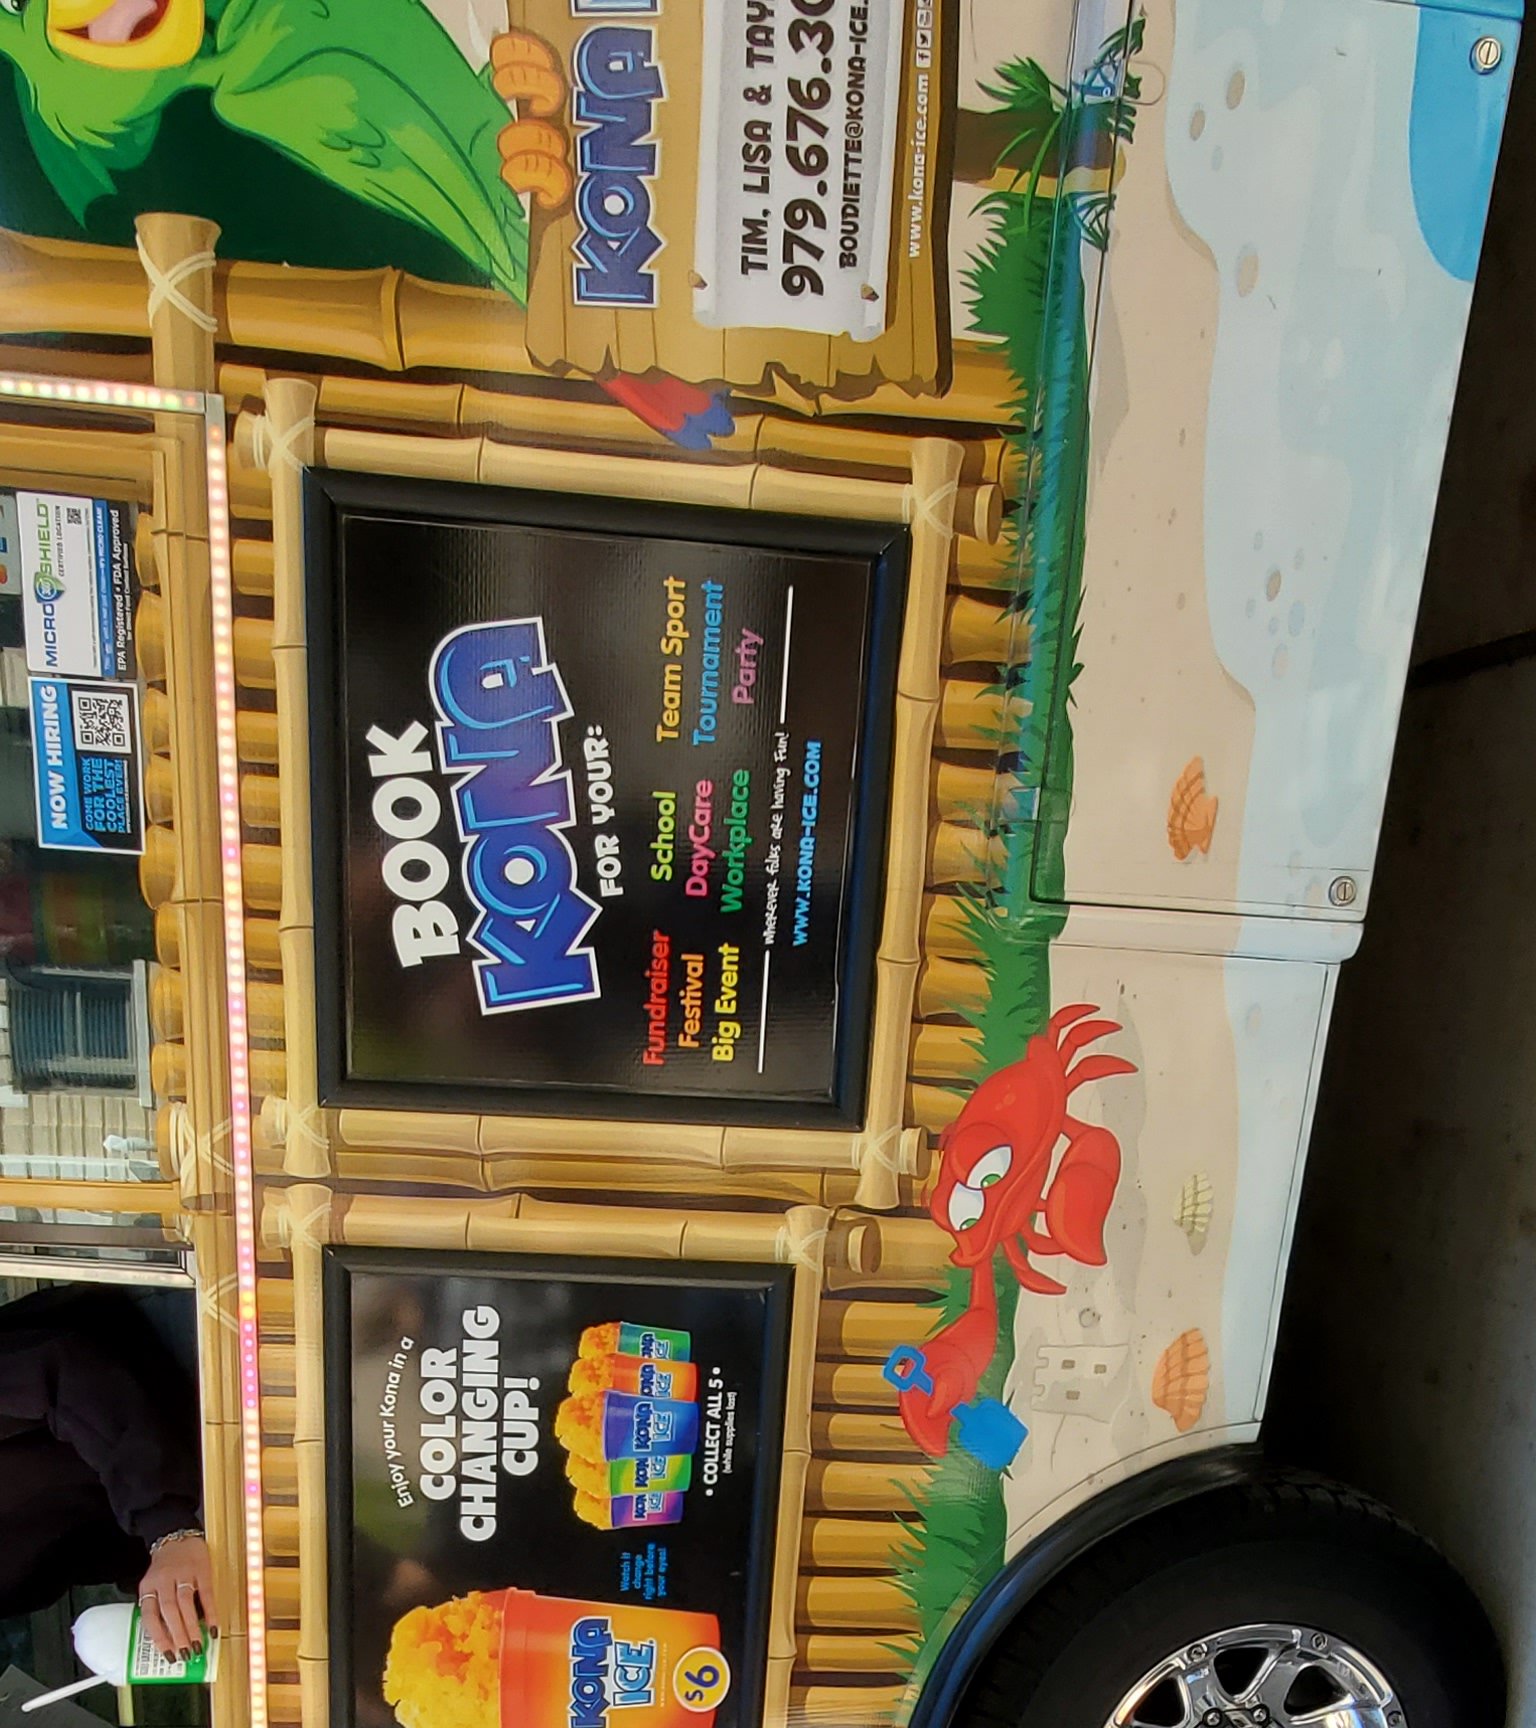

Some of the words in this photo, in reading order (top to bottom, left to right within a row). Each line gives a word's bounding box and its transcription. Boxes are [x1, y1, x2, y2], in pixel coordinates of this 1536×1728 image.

[746, 0, 774, 68] TAY
[743, 85, 772, 105] &
[570, 25, 667, 308] KONA
[742, 120, 772, 194] LISA
[907, 73, 930, 258] www.kona-ice.com
[741, 208, 772, 275] TIM,
[36, 503, 52, 575] SHIELD
[54, 505, 63, 541] LOCATION
[110, 509, 124, 561] Approved
[56, 542, 65, 577] CERTIFIED
[112, 564, 122, 585] FDA
[42, 603, 58, 667] MICRO
[114, 594, 128, 649] Registered
[660, 575, 690, 656] Sport
[117, 650, 127, 671] EPA
[691, 580, 724, 746] Tournament
[731, 627, 764, 704] Party
[655, 663, 683, 743] Team
[39, 685, 64, 766] HIRING
[773, 732, 789, 762] Fun!
[81, 757, 92, 794] WORK
[91, 757, 104, 792] THE
[104, 758, 118, 832] COOLEST
[114, 759, 125, 795] EVER!
[583, 724, 616, 825] YOUR:
[770, 768, 791, 809] having
[47, 770, 69, 829] NOW
[83, 797, 94, 831] COME
[94, 796, 107, 832] FOR
[116, 796, 126, 833] PLACE
[428, 615, 603, 1015] KONA
[365, 719, 461, 968] BOOK
[649, 790, 677, 882] School
[685, 778, 716, 898] DayCare
[720, 769, 753, 913] Workplace
[768, 813, 784, 840] are
[792, 741, 822, 947] WWW.KONA-ICE.COM
[594, 834, 624, 898] FOR
[764, 845, 782, 875] folks
[642, 929, 670, 1066] Fundraiser
[715, 942, 740, 1014] Event
[678, 952, 704, 1048] Festival
[712, 1021, 741, 1062] Big
[387, 1352, 408, 1369] in
[399, 1335, 414, 1351] a
[379, 1372, 401, 1417] Kona
[639, 1364, 656, 1396] ONA
[709, 1378, 723, 1389] 5
[726, 1391, 738, 1410] last)
[419, 1347, 457, 1501] COLOR
[459, 1305, 500, 1542] CHANGING
[707, 1392, 722, 1419] ALL
[381, 1420, 402, 1460] your
[501, 1376, 540, 1477] CUP!
[632, 1401, 654, 1452] KONA
[651, 1411, 672, 1442] ICE
[724, 1411, 736, 1447] supplies
[703, 1421, 721, 1485] COLLECT
[722, 1448, 733, 1474] (while
[386, 1463, 415, 1508] Enjoy
[634, 1458, 650, 1490] KON
[632, 1494, 649, 1521] KON
[619, 1561, 631, 1591] Watch
[620, 1551, 631, 1560] it
[632, 1554, 644, 1589] change
[644, 1543, 655, 1576] before
[657, 1547, 668, 1573] eyes!
[643, 1578, 655, 1600] right
[657, 1575, 668, 1597] your
[612, 1640, 657, 1707] ICE
[684, 1665, 720, 1703] $6
